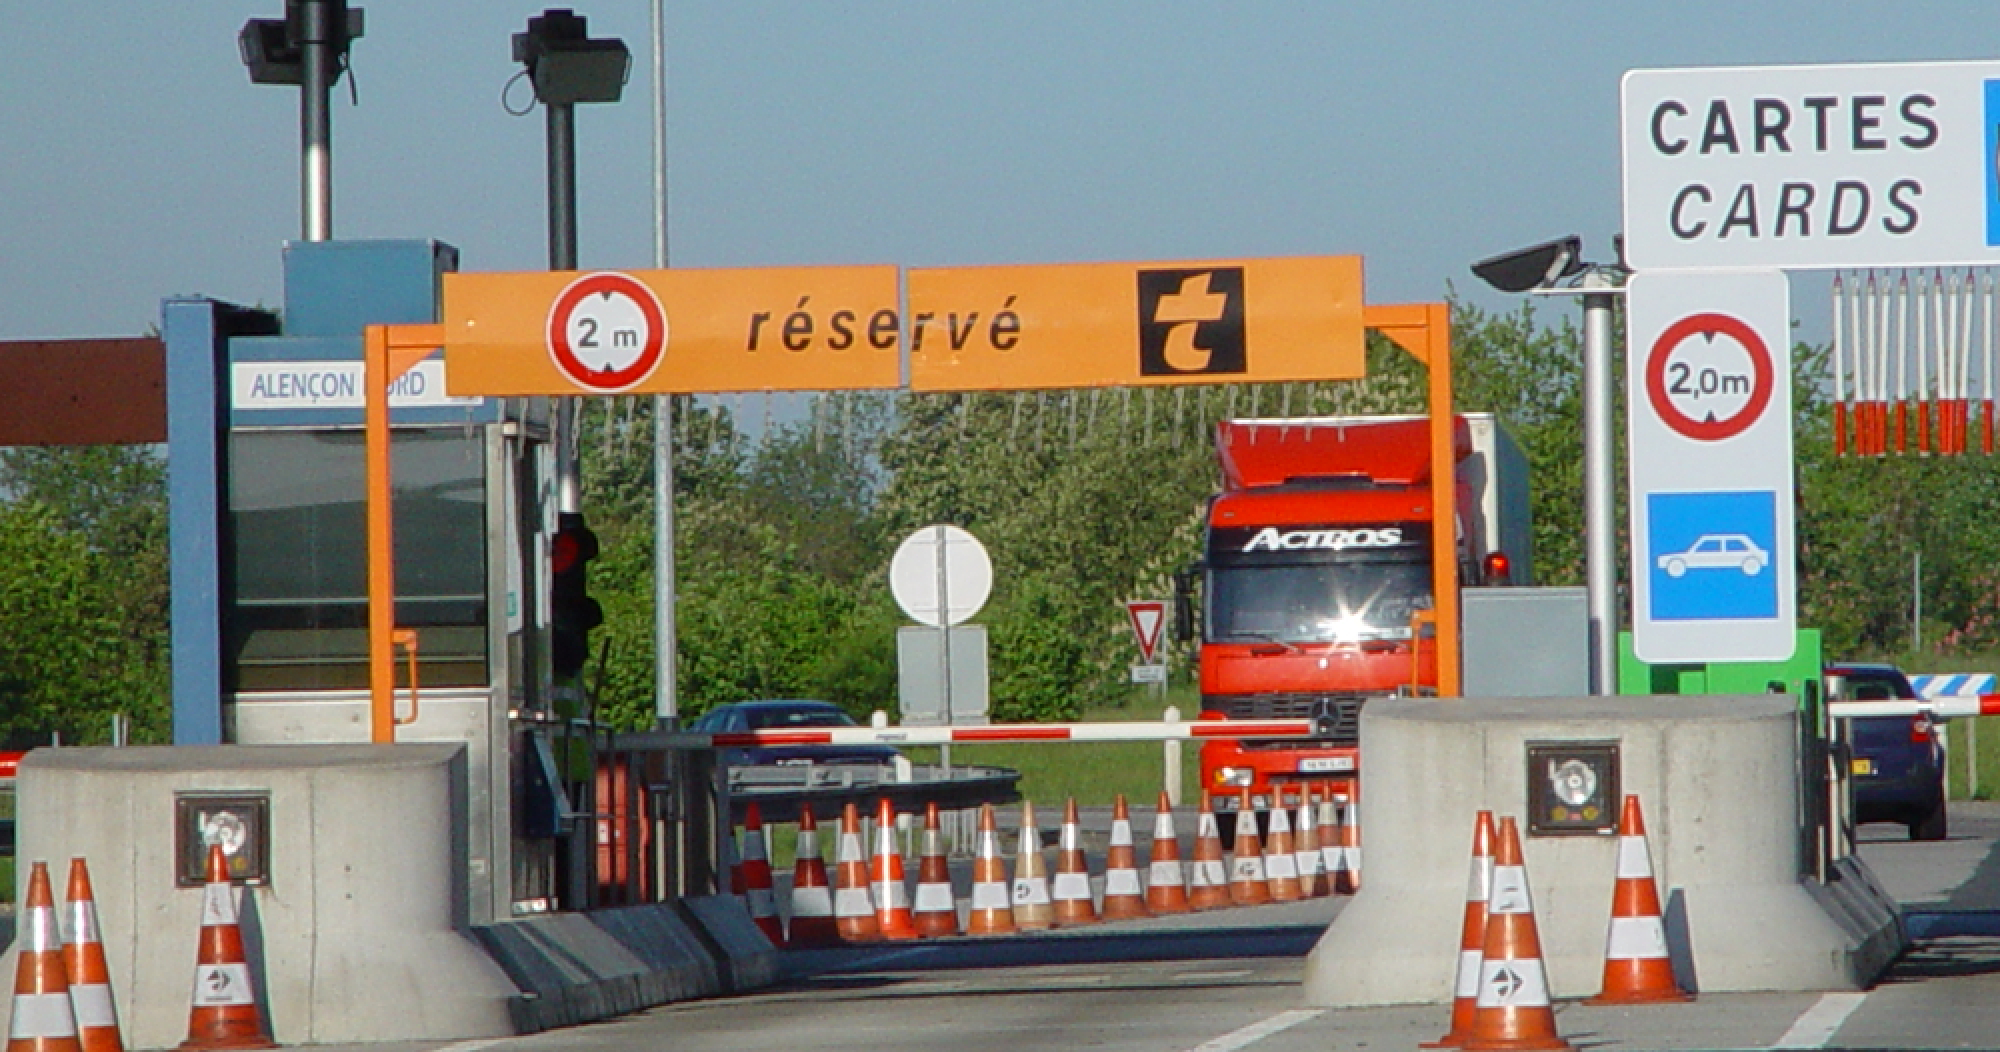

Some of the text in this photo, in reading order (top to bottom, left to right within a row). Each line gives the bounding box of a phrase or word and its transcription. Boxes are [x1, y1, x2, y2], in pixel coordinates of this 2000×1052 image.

[1651, 93, 1939, 156] CARTES
[1669, 179, 1923, 240] CARDS
[577, 317, 639, 348] 2 m
[747, 295, 1022, 352] réservé
[251, 372, 355, 405] ALENÇON
[1669, 361, 1750, 401] 2,0m
